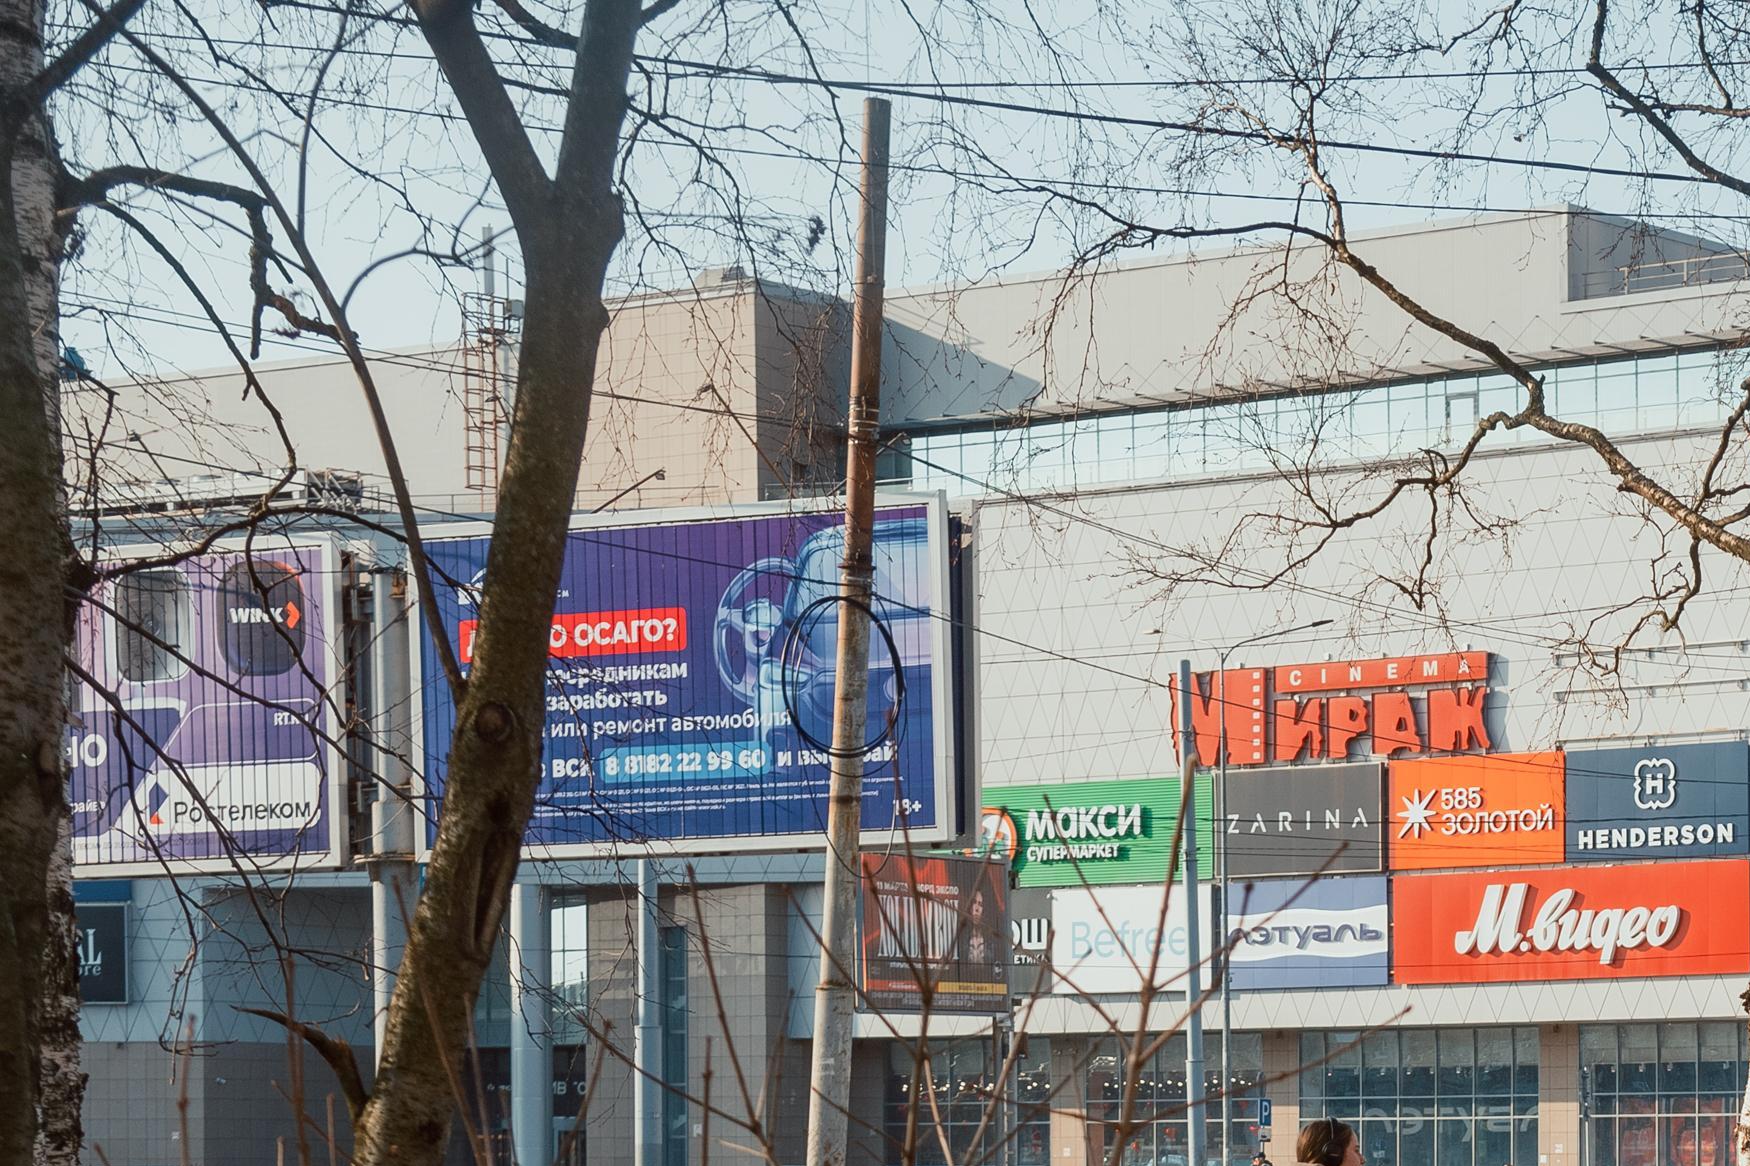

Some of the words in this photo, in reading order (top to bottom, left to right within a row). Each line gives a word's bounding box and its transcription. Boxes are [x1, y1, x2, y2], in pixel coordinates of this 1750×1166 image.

[574, 617, 678, 648] ОСАГО?
[1289, 660, 1471, 686] CINEMA
[546, 689, 668, 716] заработать
[594, 719, 667, 740] ремонт
[672, 708, 791, 732] автомобиля
[1169, 667, 1491, 768] МИРАЖ
[552, 760, 595, 778] ВСК
[605, 756, 619, 776] 8
[624, 752, 672, 775] 8182
[677, 752, 701, 772] 22
[706, 748, 733, 771] 99
[738, 748, 766, 768] 60
[778, 751, 792, 767] и
[1441, 785, 1482, 810] 585
[175, 801, 311, 823] Ростелеком
[1226, 807, 1369, 834] ZARINA
[1441, 803, 1555, 836] ЗОЛОТОЙ
[1577, 822, 1734, 850] HENDERSON
[1026, 842, 1120, 862] СУПЕРМАРКЕТ
[1071, 919, 1187, 959] Befree
